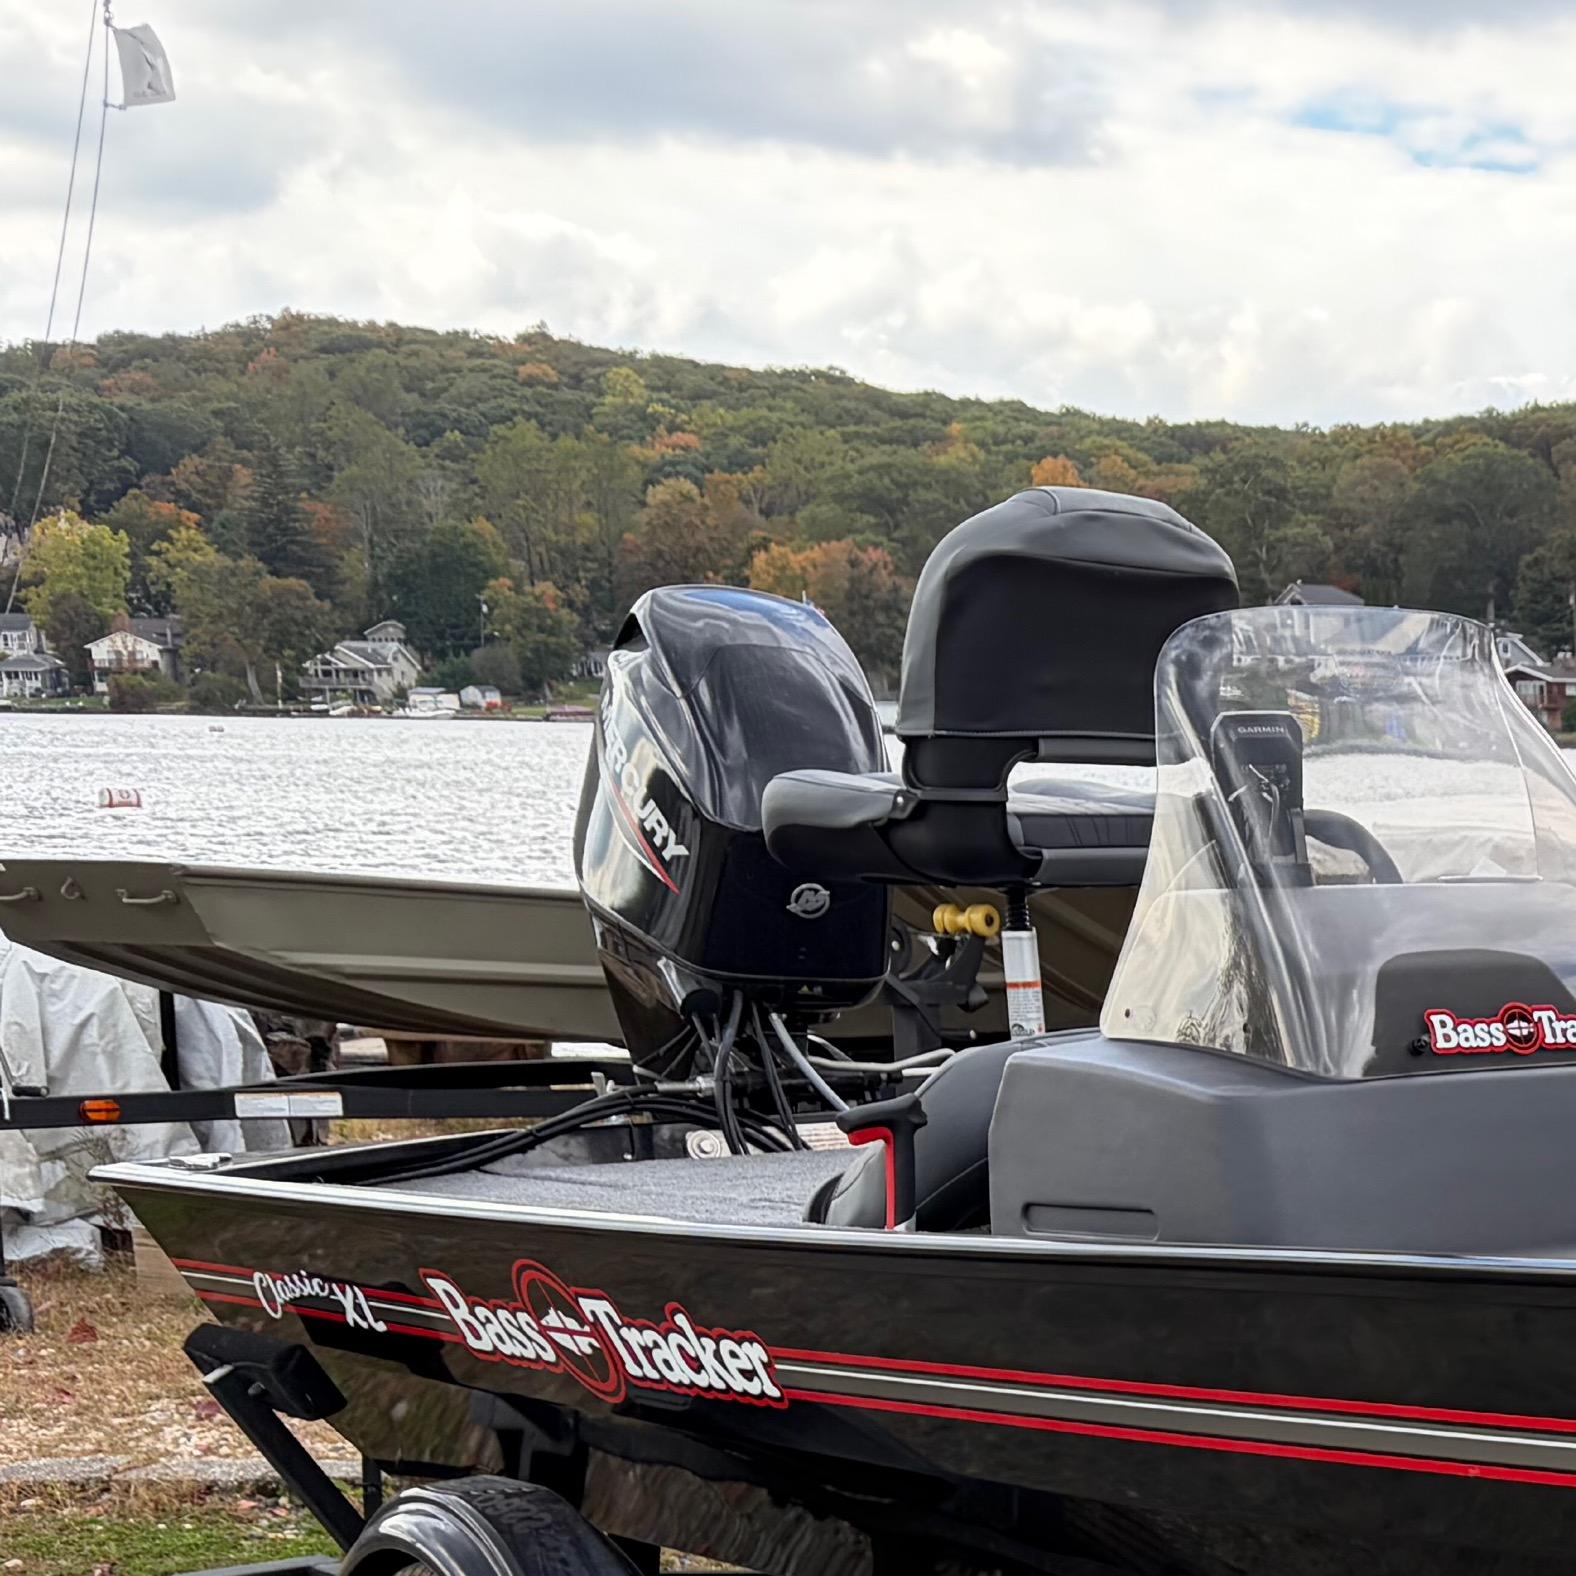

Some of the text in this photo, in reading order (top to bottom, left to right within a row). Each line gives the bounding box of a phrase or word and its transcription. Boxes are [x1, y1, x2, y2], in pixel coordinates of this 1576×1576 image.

[1237, 726, 1285, 734] GARMIN
[1432, 1013, 1505, 1050] Bass
[253, 1270, 388, 1333] Classic XL
[425, 1276, 782, 1400] Bass Tracker
